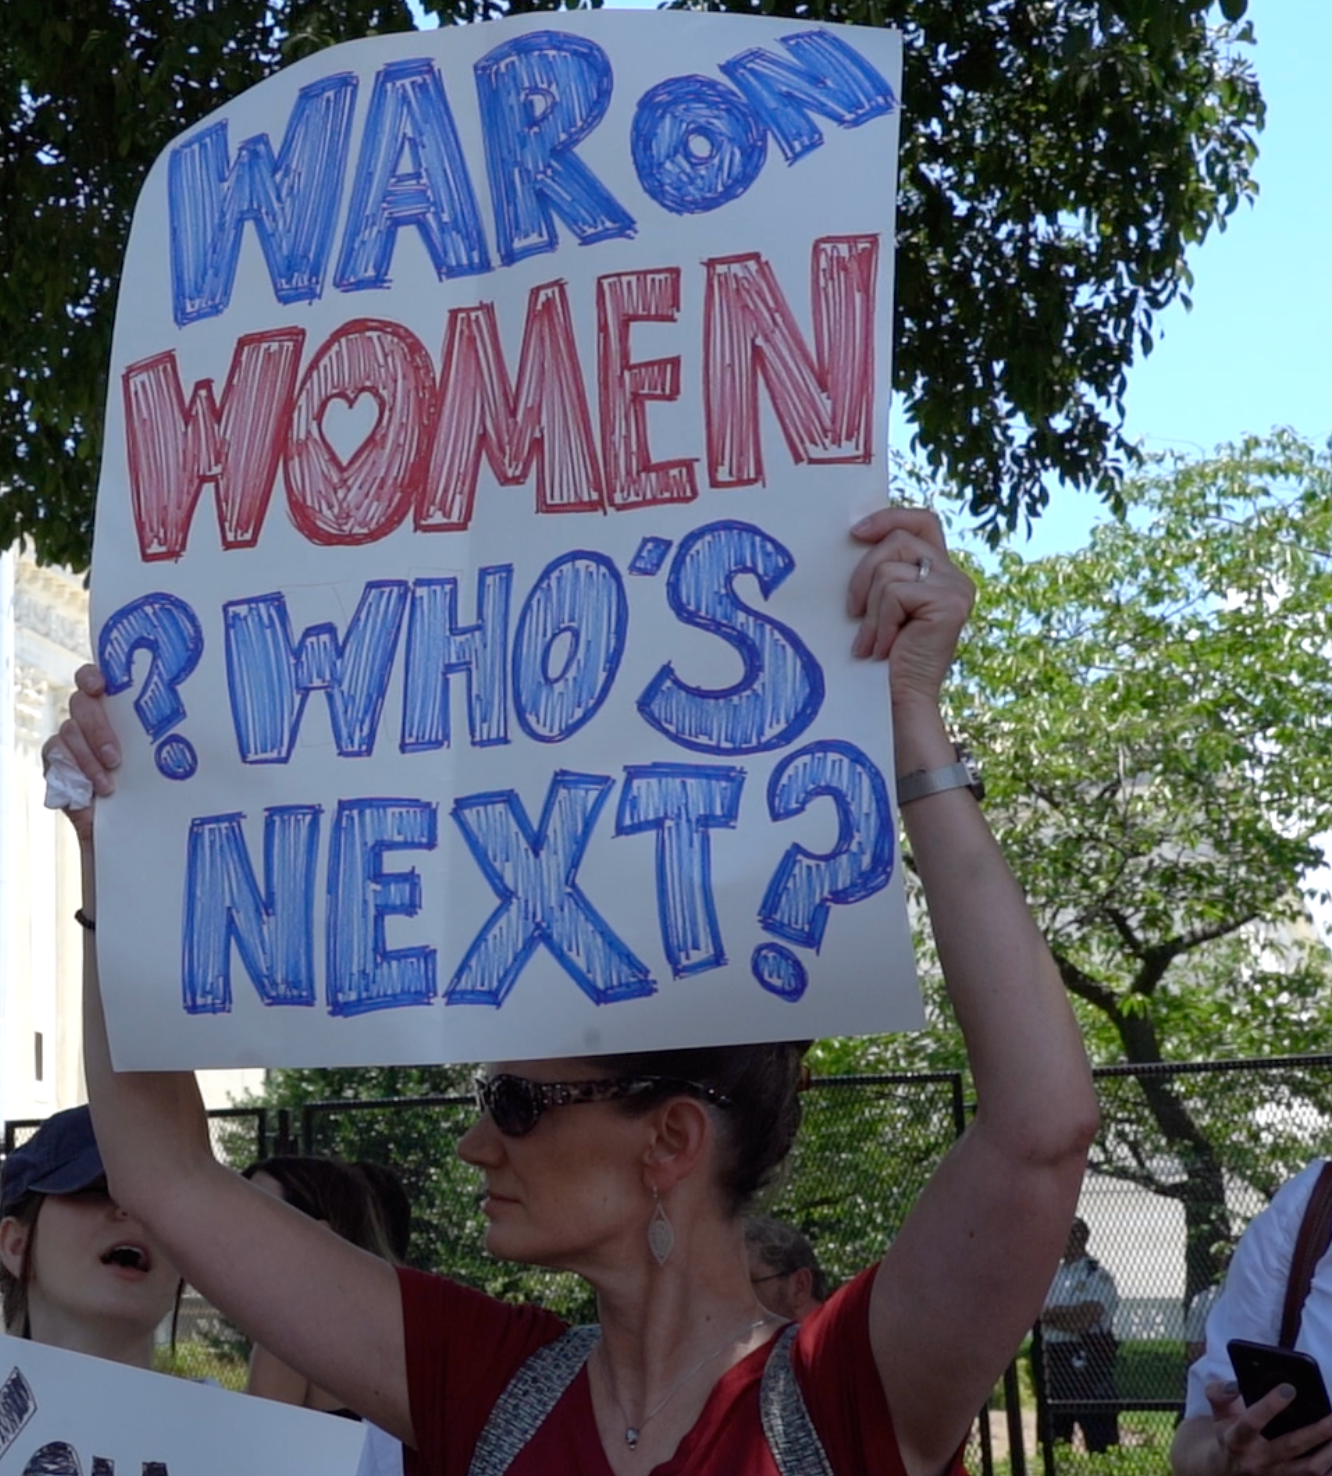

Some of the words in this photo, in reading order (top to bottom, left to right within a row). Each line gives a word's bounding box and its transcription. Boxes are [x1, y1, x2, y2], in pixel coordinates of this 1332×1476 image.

[167, 30, 636, 327] WAR
[630, 28, 898, 216] ON
[122, 232, 880, 561] WOMEN
[181, 739, 896, 1017] NEXT?
